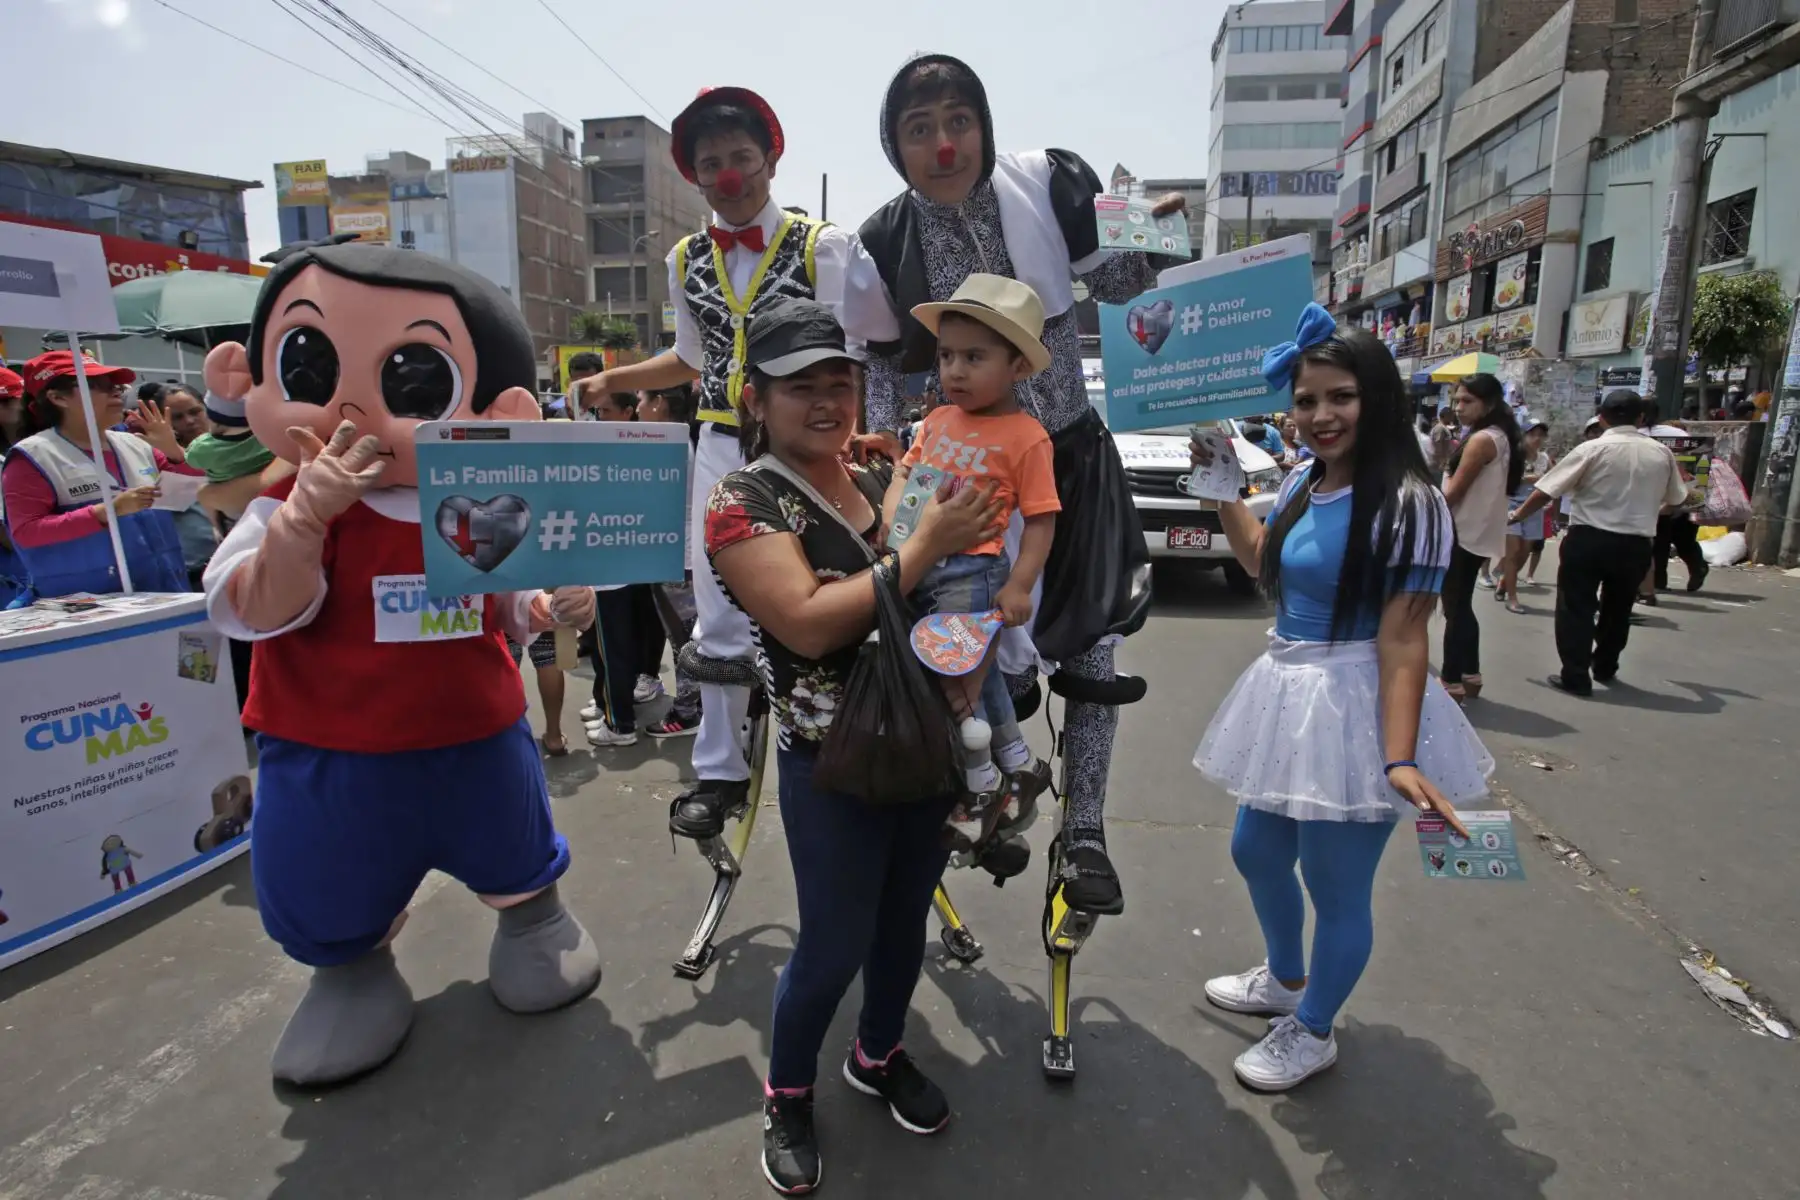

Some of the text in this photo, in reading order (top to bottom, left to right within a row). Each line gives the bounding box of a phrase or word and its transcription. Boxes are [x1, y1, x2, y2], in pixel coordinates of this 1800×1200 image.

[1208, 297, 1246, 314] Amor
[1208, 307, 1272, 329] DeHierro
[1133, 364, 1158, 379] Dale
[1160, 362, 1174, 375] de
[1176, 356, 1212, 372] lactar
[1213, 356, 1221, 365] a
[1223, 351, 1242, 364] tus
[1130, 382, 1145, 395] los
[1147, 374, 1197, 394] proteges
[1198, 374, 1206, 387] y
[1207, 366, 1247, 383] cuidas
[1147, 402, 1156, 411] Te
[1165, 396, 1199, 409] recuerda
[1207, 385, 1268, 402] #FamiliaMIDIS
[68, 482, 100, 495] MIDIS
[430, 464, 680, 486] La Familia MIDIS tiene un
[538, 510, 644, 551] # Amor
[586, 531, 679, 547] DeHierro
[377, 580, 416, 589] Programa
[380, 590, 461, 614] CUNA
[421, 608, 480, 635] MAS
[20, 692, 121, 724] Programa Nacional
[25, 702, 137, 751] CUNA
[85, 716, 170, 765] MAS
[13, 748, 179, 809] Nuestras niñas y niños crecen
[26, 760, 176, 817] sanos, inteligentes y felices
